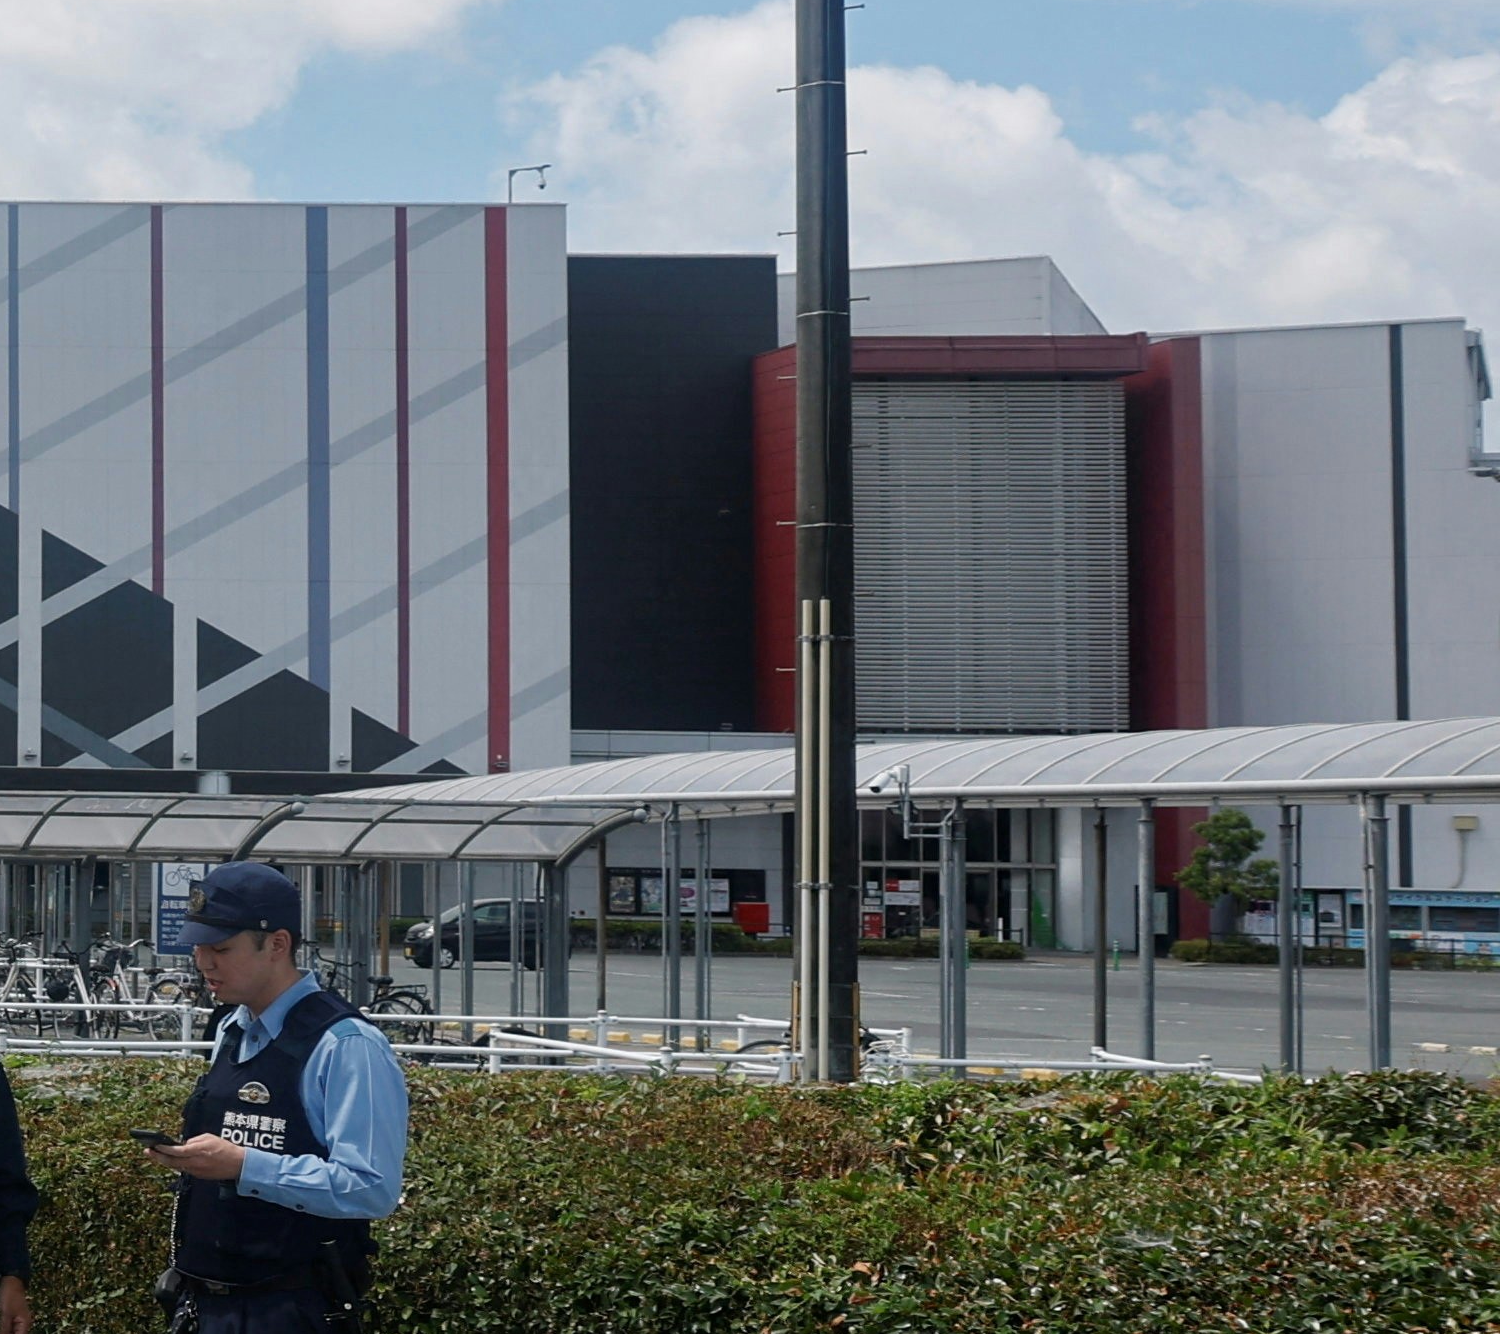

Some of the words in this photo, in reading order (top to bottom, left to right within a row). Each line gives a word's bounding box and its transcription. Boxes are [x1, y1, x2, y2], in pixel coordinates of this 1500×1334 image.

[222, 1111, 287, 1134] 熊本県警察
[220, 1127, 286, 1151] POLICE
